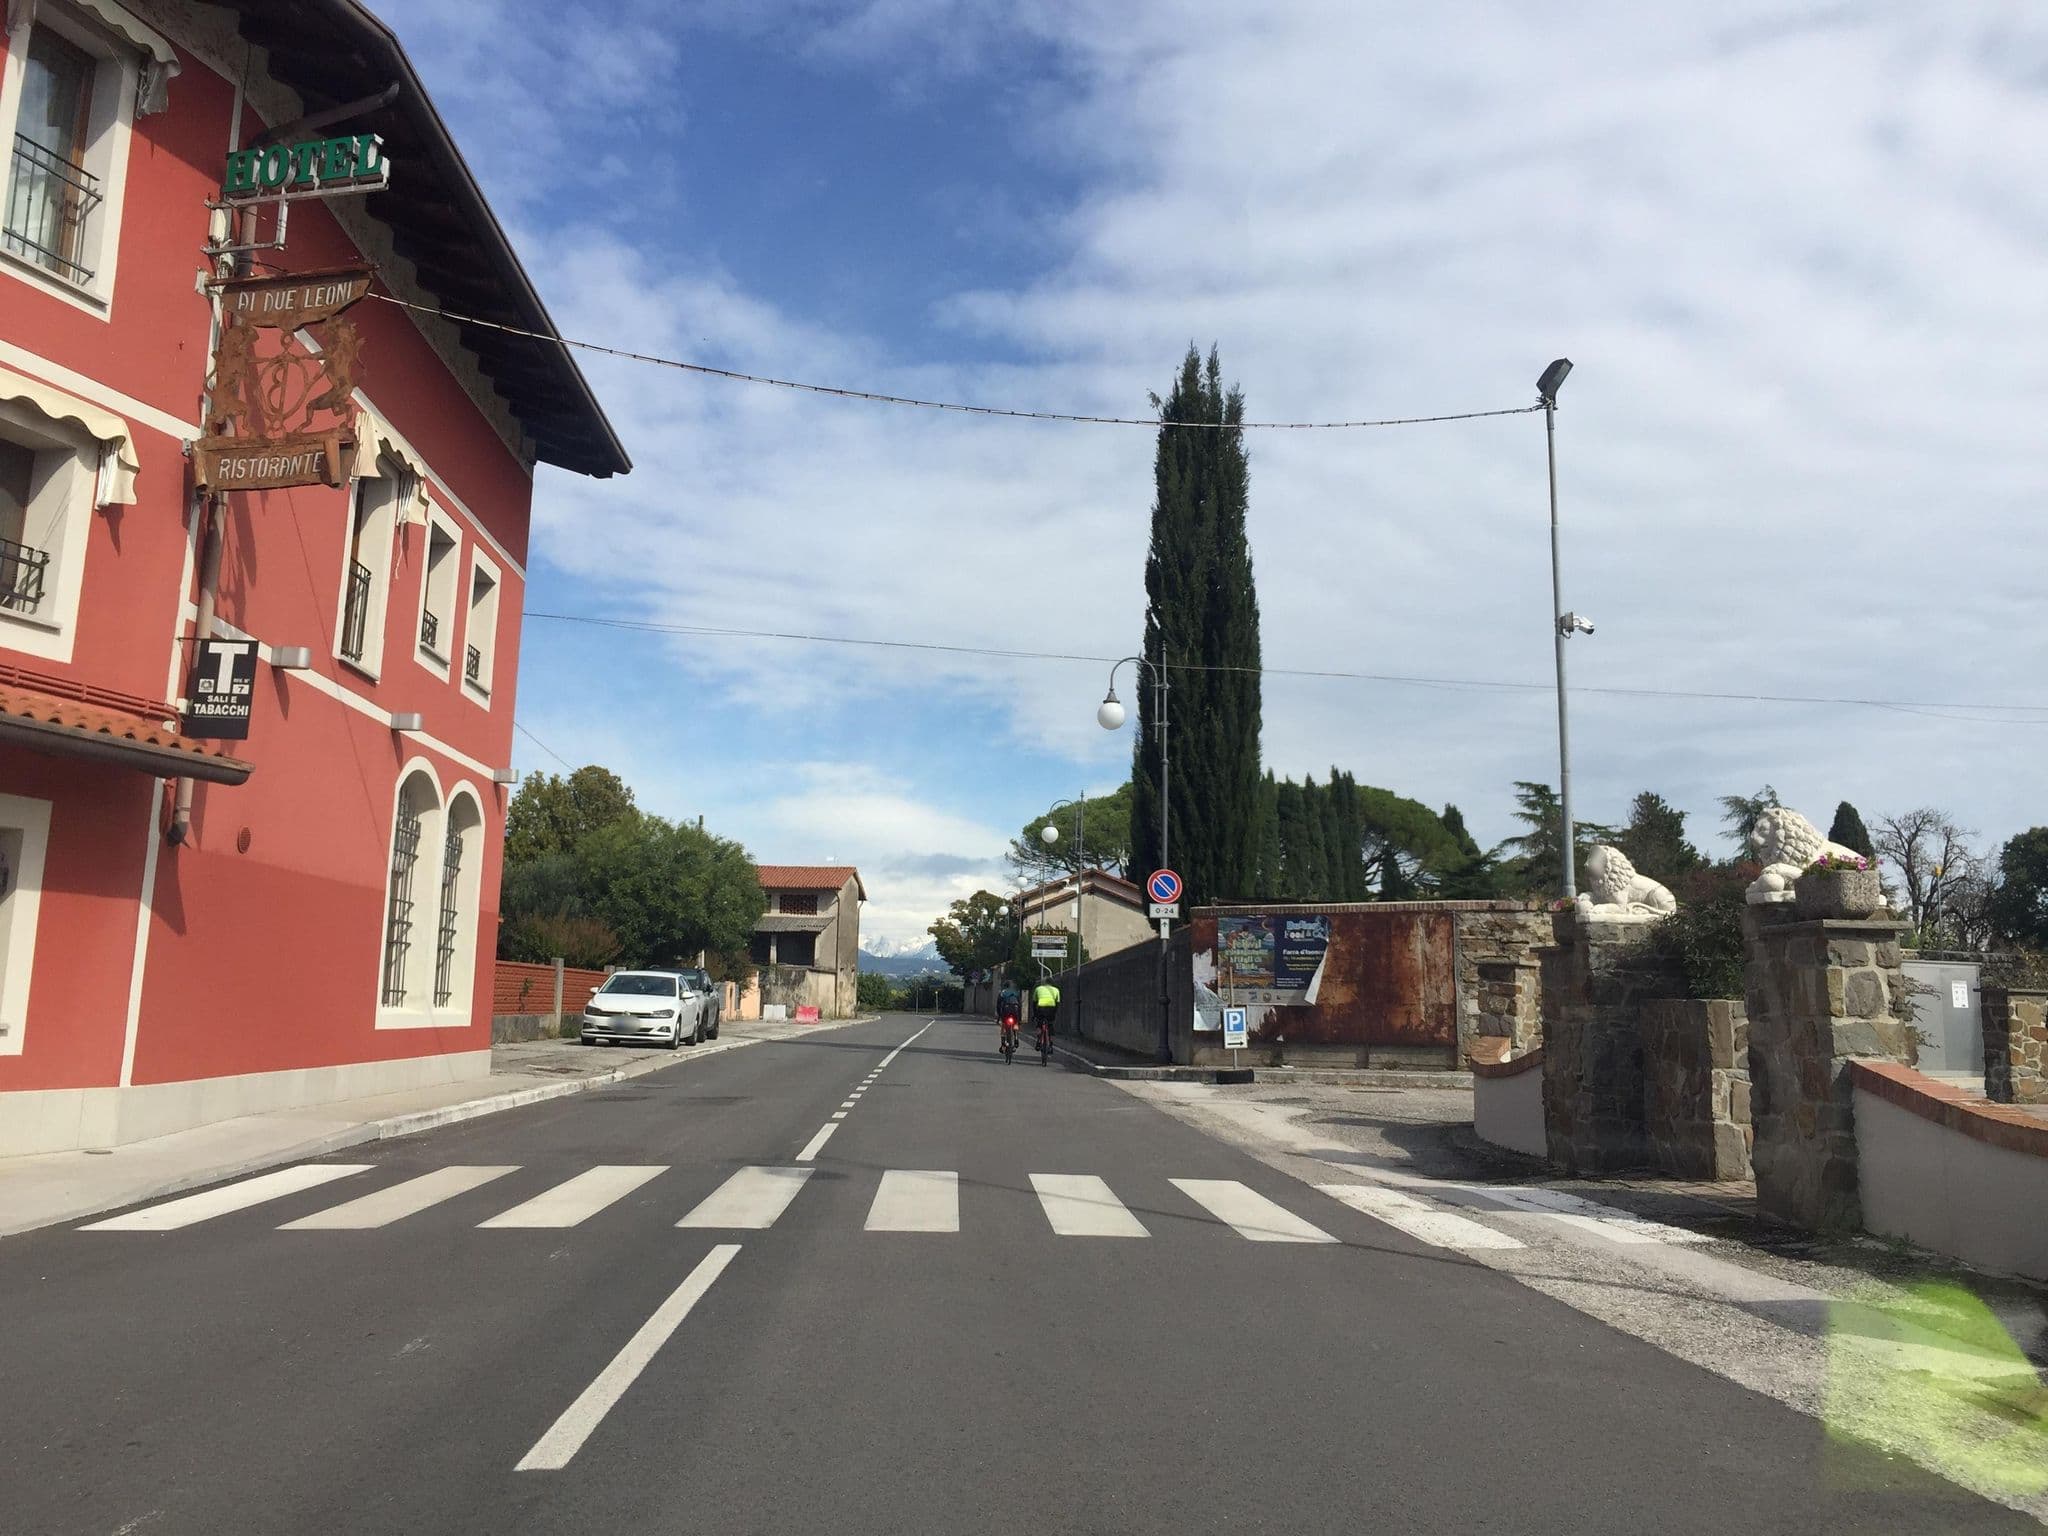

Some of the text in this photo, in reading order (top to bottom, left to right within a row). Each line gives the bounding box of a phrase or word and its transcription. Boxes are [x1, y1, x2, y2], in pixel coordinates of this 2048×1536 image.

[222, 134, 385, 192] HOTEL
[238, 281, 353, 312] AI DUE LEONI
[218, 451, 325, 480] RISTORANTE
[208, 642, 249, 694] T
[194, 703, 249, 717] TABACCHI
[207, 695, 237, 704] SALI E
[1229, 1012, 1241, 1030] P
